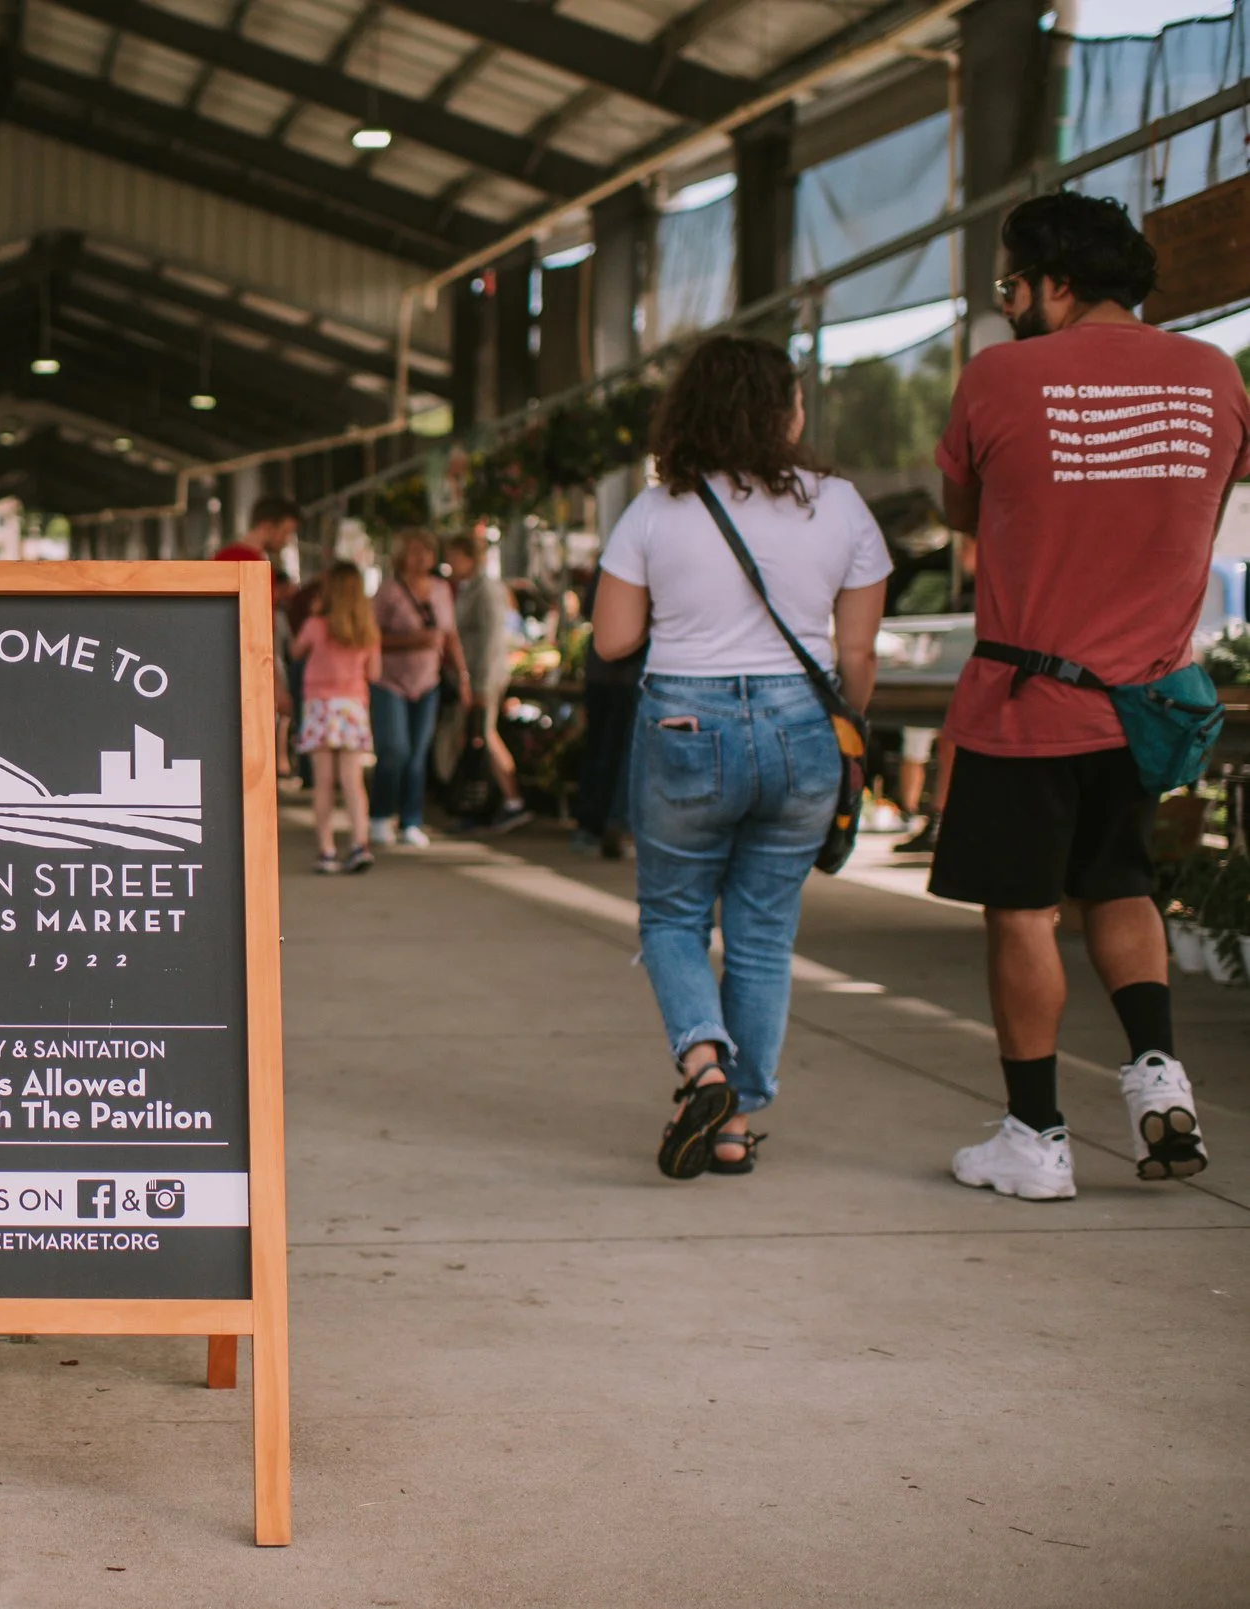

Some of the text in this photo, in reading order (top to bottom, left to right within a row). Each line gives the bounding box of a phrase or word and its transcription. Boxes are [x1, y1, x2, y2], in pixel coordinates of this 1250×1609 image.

[113, 647, 169, 698] TO
[33, 863, 203, 898] STREET
[36, 909, 186, 933] MARKET
[28, 953, 128, 972] 1922
[12, 1039, 28, 1058] &
[33, 1039, 165, 1059] SANITATION
[21, 1067, 146, 1097] Allowed
[20, 1100, 81, 1129] The
[91, 1100, 212, 1129] Pavilion
[18, 1188, 63, 1211] ON
[121, 1189, 141, 1212] &
